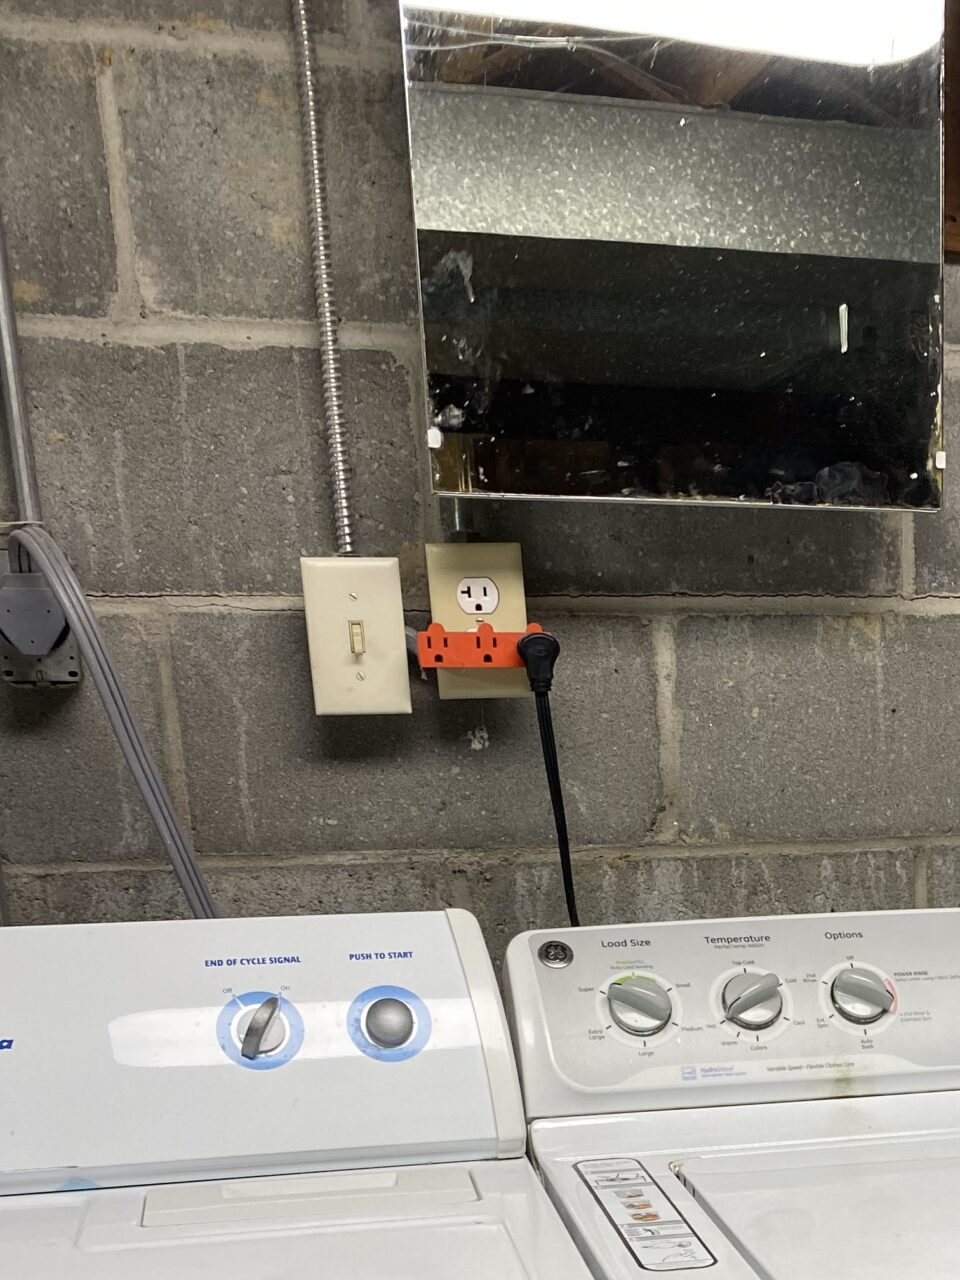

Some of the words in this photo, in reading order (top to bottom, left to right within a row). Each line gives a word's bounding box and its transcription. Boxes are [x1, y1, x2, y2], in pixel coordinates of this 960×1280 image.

[704, 934, 771, 945] Temperature
[824, 931, 864, 940] Options
[601, 938, 628, 948] Load
[630, 938, 651, 947] Size
[349, 953, 372, 961] PUSH
[374, 952, 386, 960] TO
[388, 951, 413, 959] START
[205, 959, 224, 967] END
[226, 958, 237, 966] OF
[240, 957, 267, 966] CYCLE
[269, 956, 302, 964] SIGNAL
